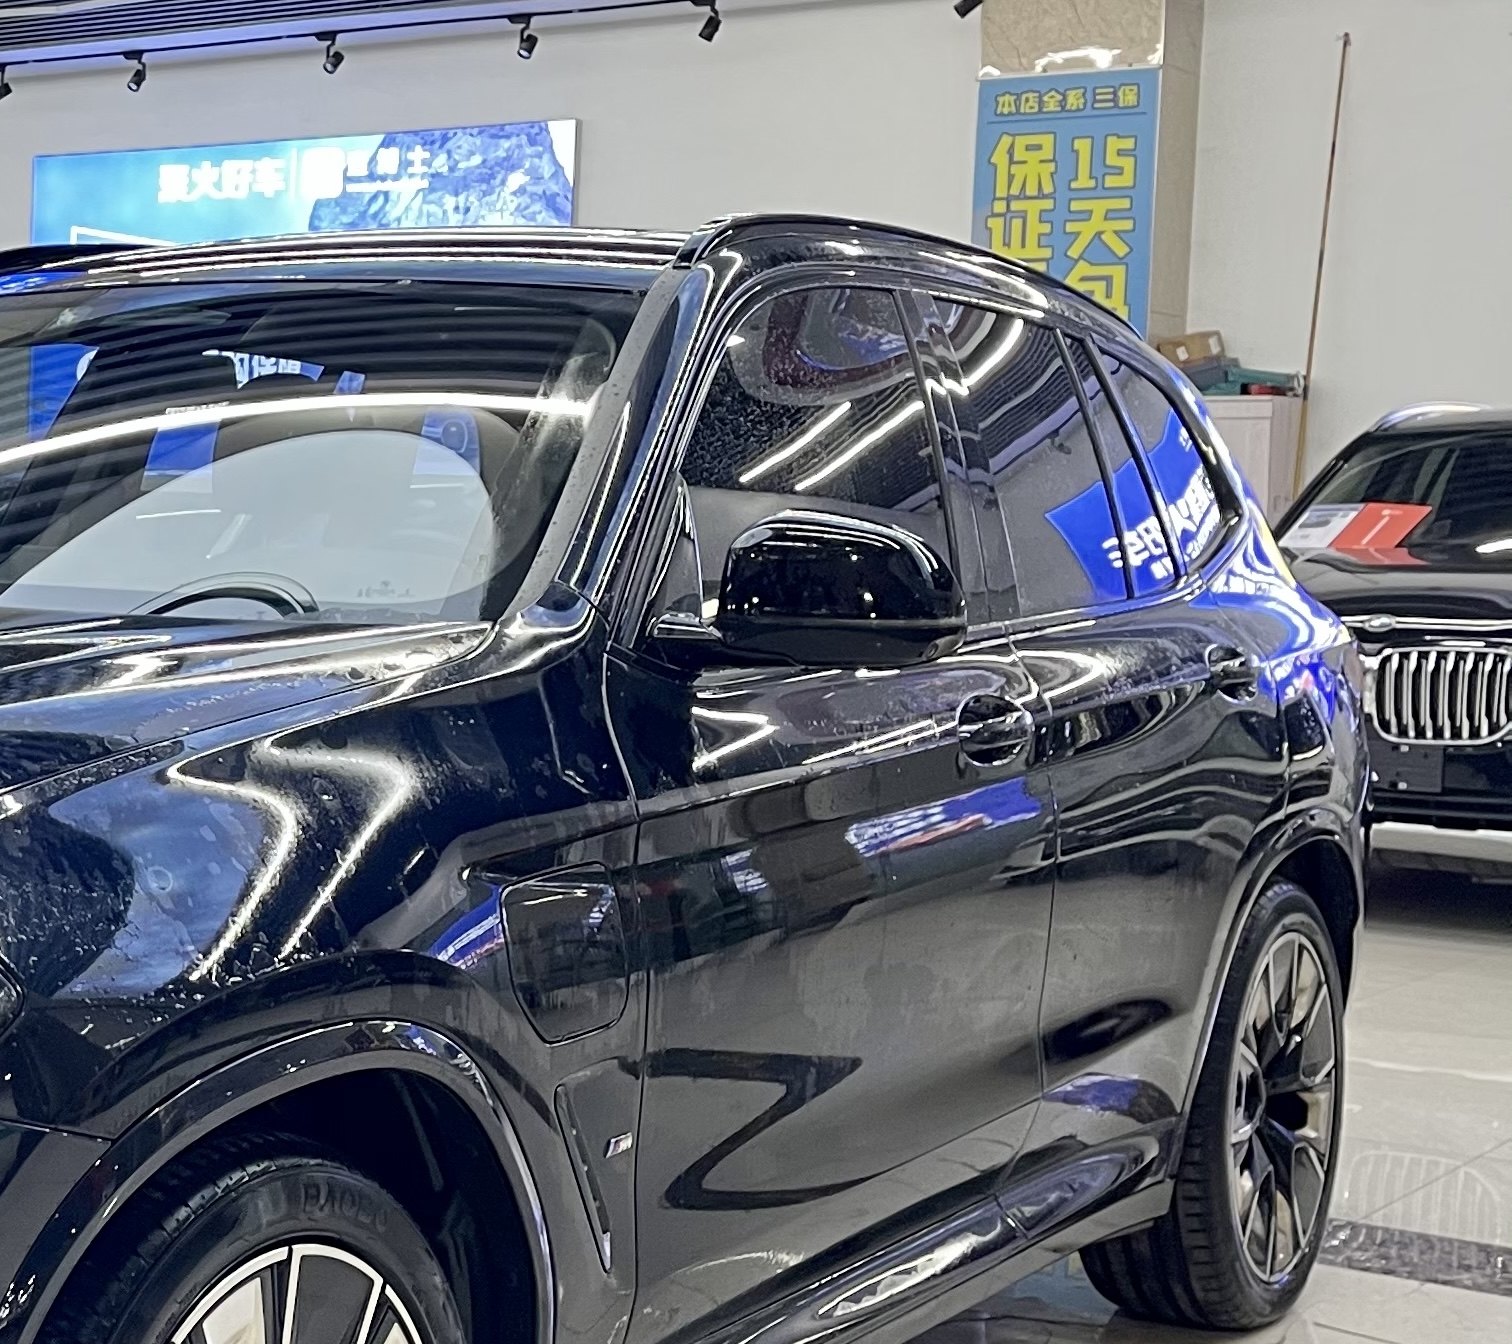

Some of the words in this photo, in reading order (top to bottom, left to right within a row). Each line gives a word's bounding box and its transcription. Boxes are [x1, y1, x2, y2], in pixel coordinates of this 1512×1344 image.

[994, 86, 1087, 116] 本店全系
[1092, 82, 1141, 110] 三保
[986, 131, 1058, 273] 保证
